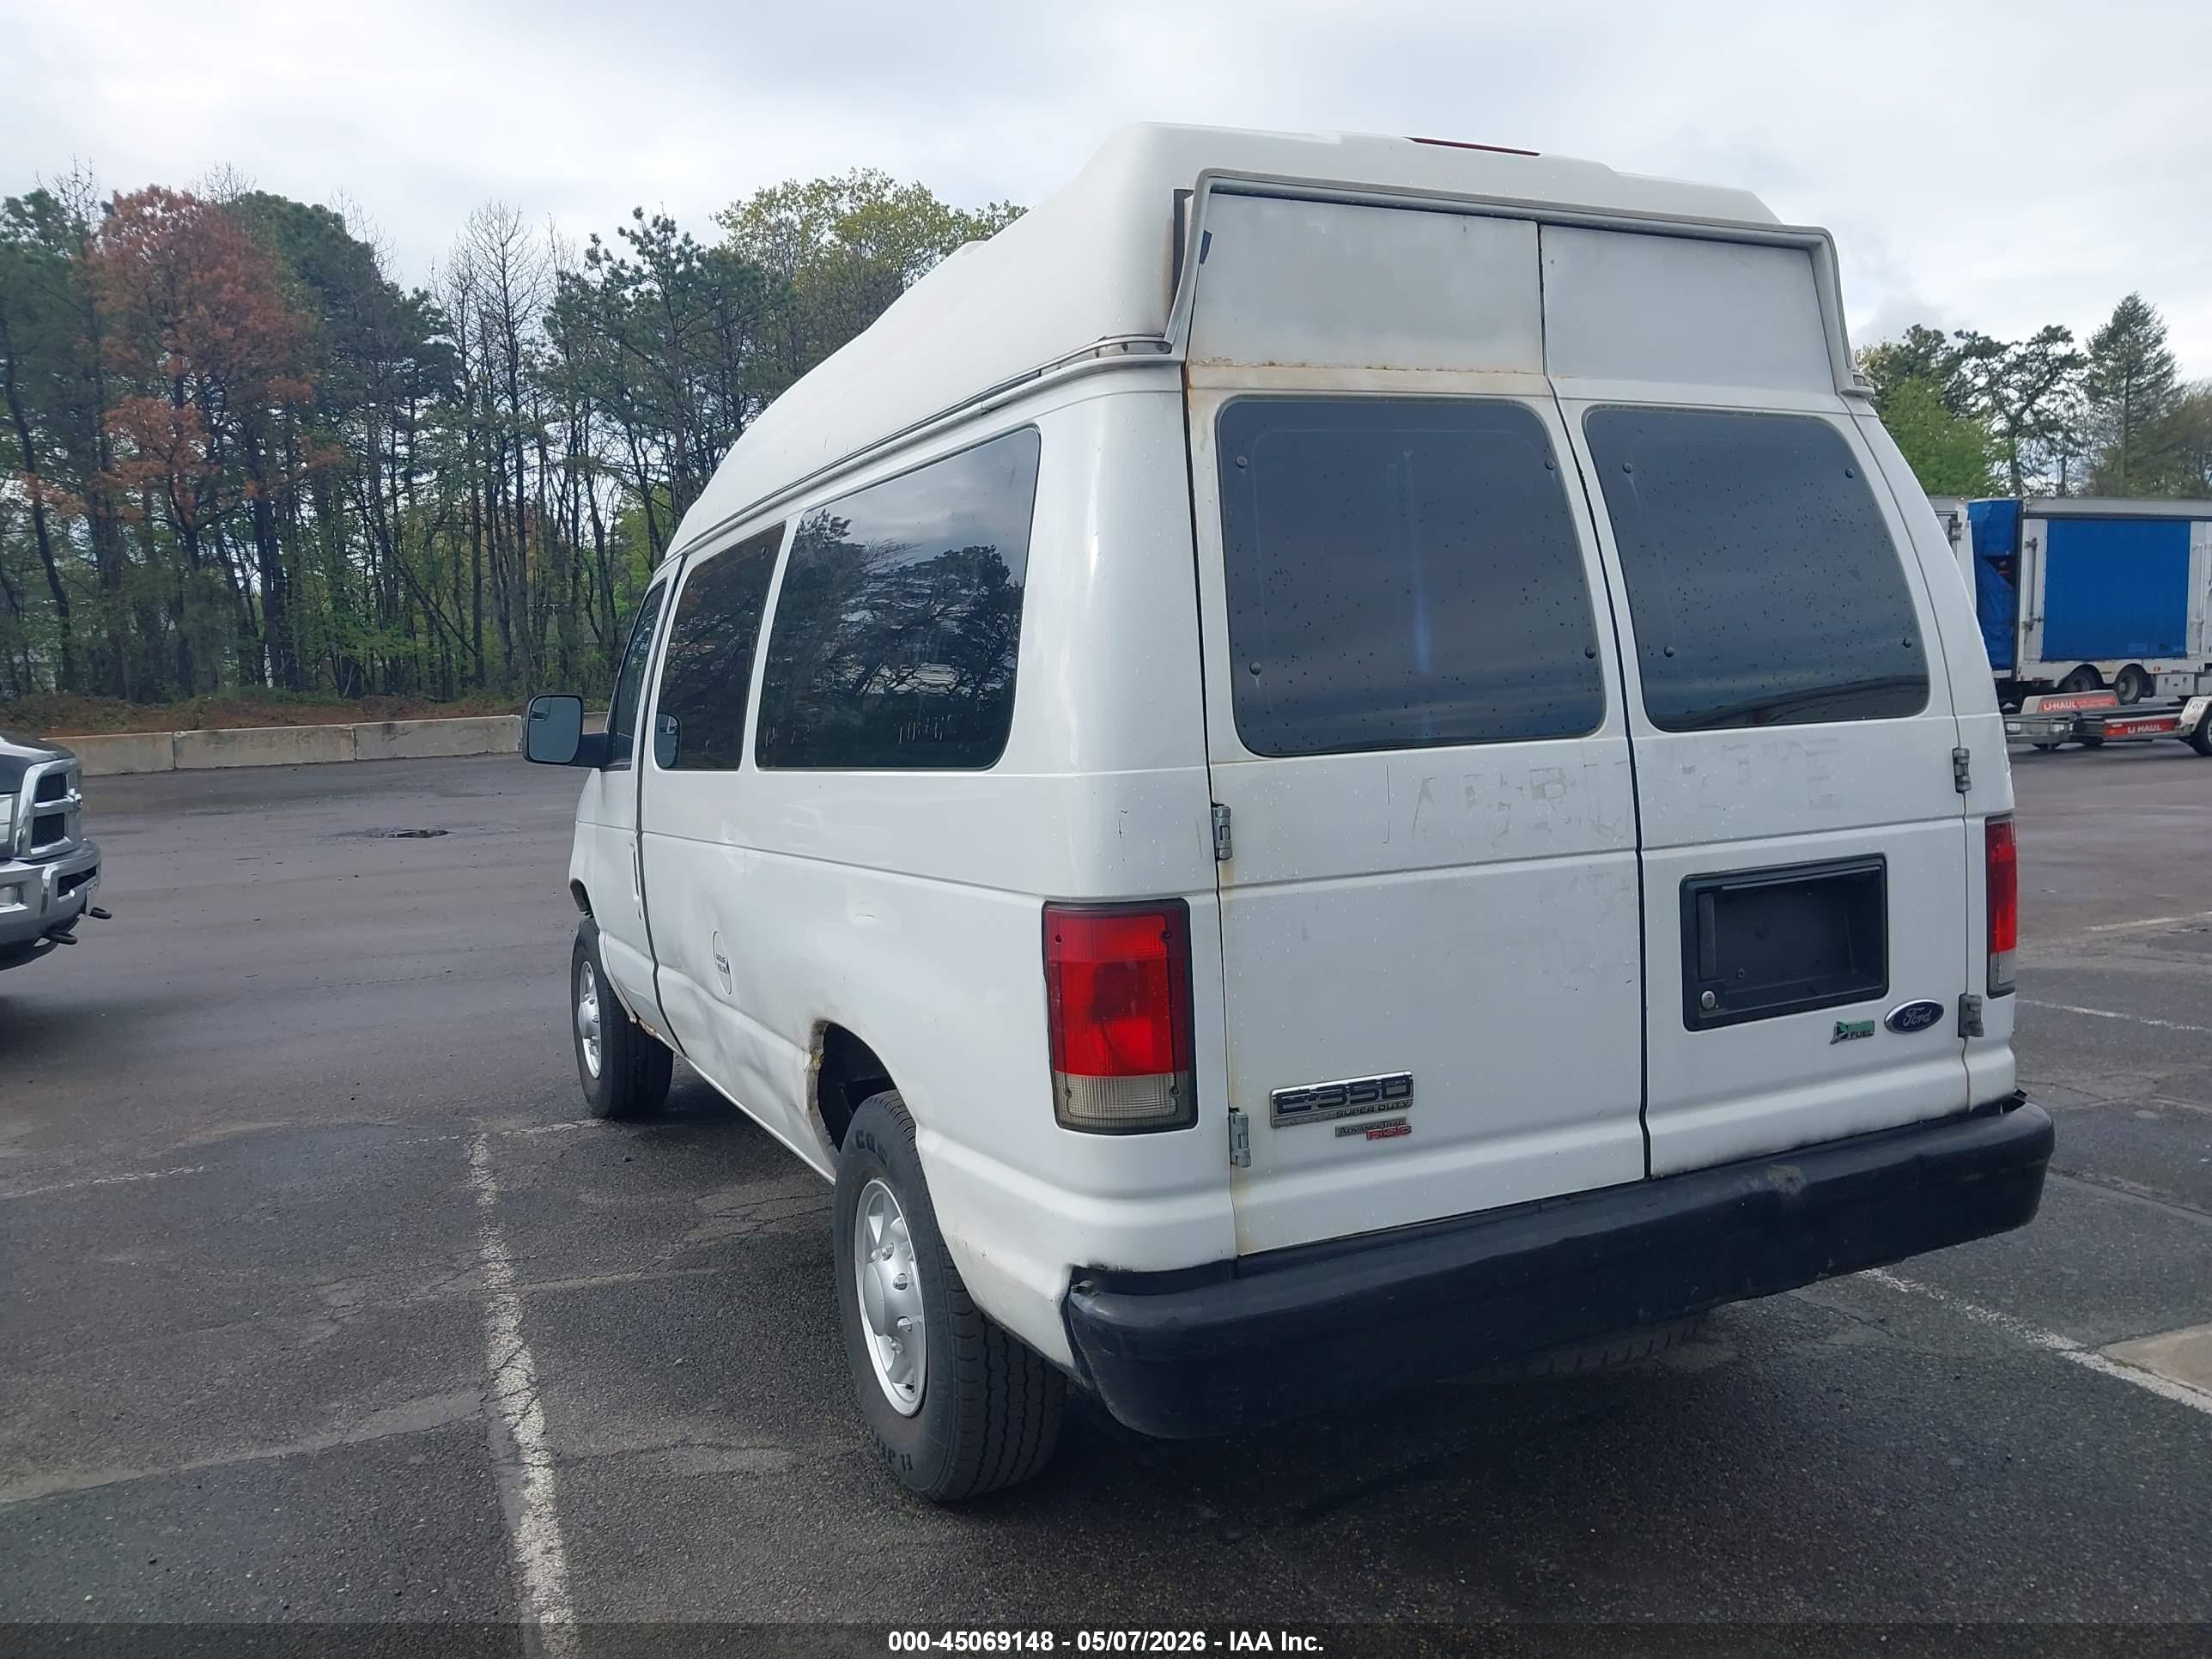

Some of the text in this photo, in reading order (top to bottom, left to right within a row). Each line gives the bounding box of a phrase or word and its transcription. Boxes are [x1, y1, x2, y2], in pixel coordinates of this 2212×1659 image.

[1901, 1006, 1932, 1027] Ford
[1277, 1075, 1412, 1114] E-350
[1336, 1100, 1409, 1118] SUPER DUTY
